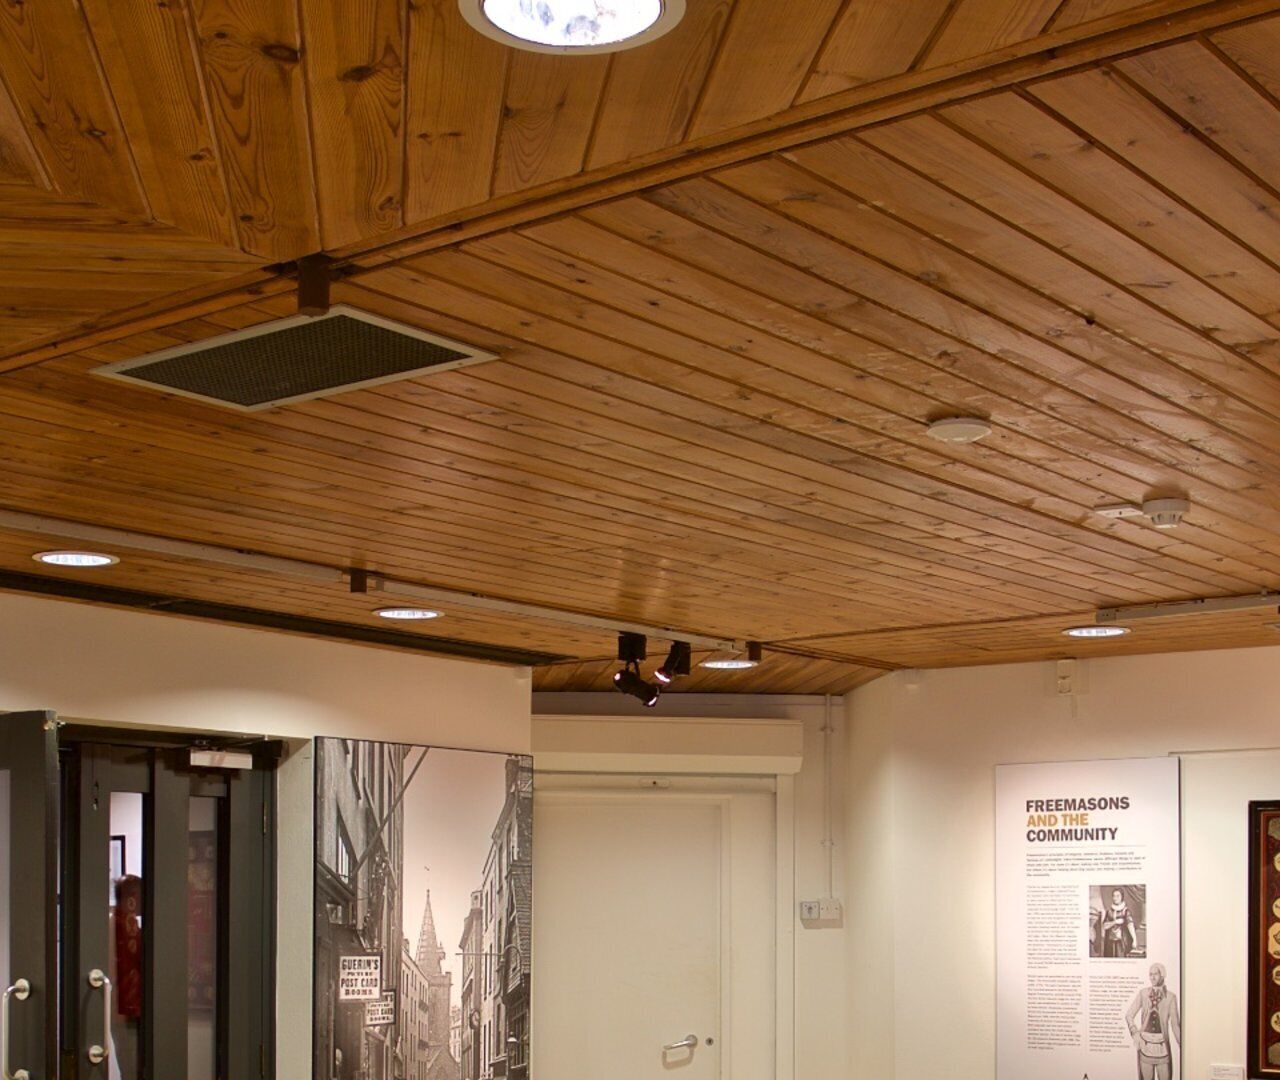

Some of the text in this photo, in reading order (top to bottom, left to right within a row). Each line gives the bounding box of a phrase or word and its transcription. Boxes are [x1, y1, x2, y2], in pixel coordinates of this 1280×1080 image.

[1026, 797, 1130, 812] FREEMASONS
[1027, 813, 1089, 827] AND THE
[1026, 827, 1118, 842] COMMUNITY
[341, 978, 378, 988] POST CARD
